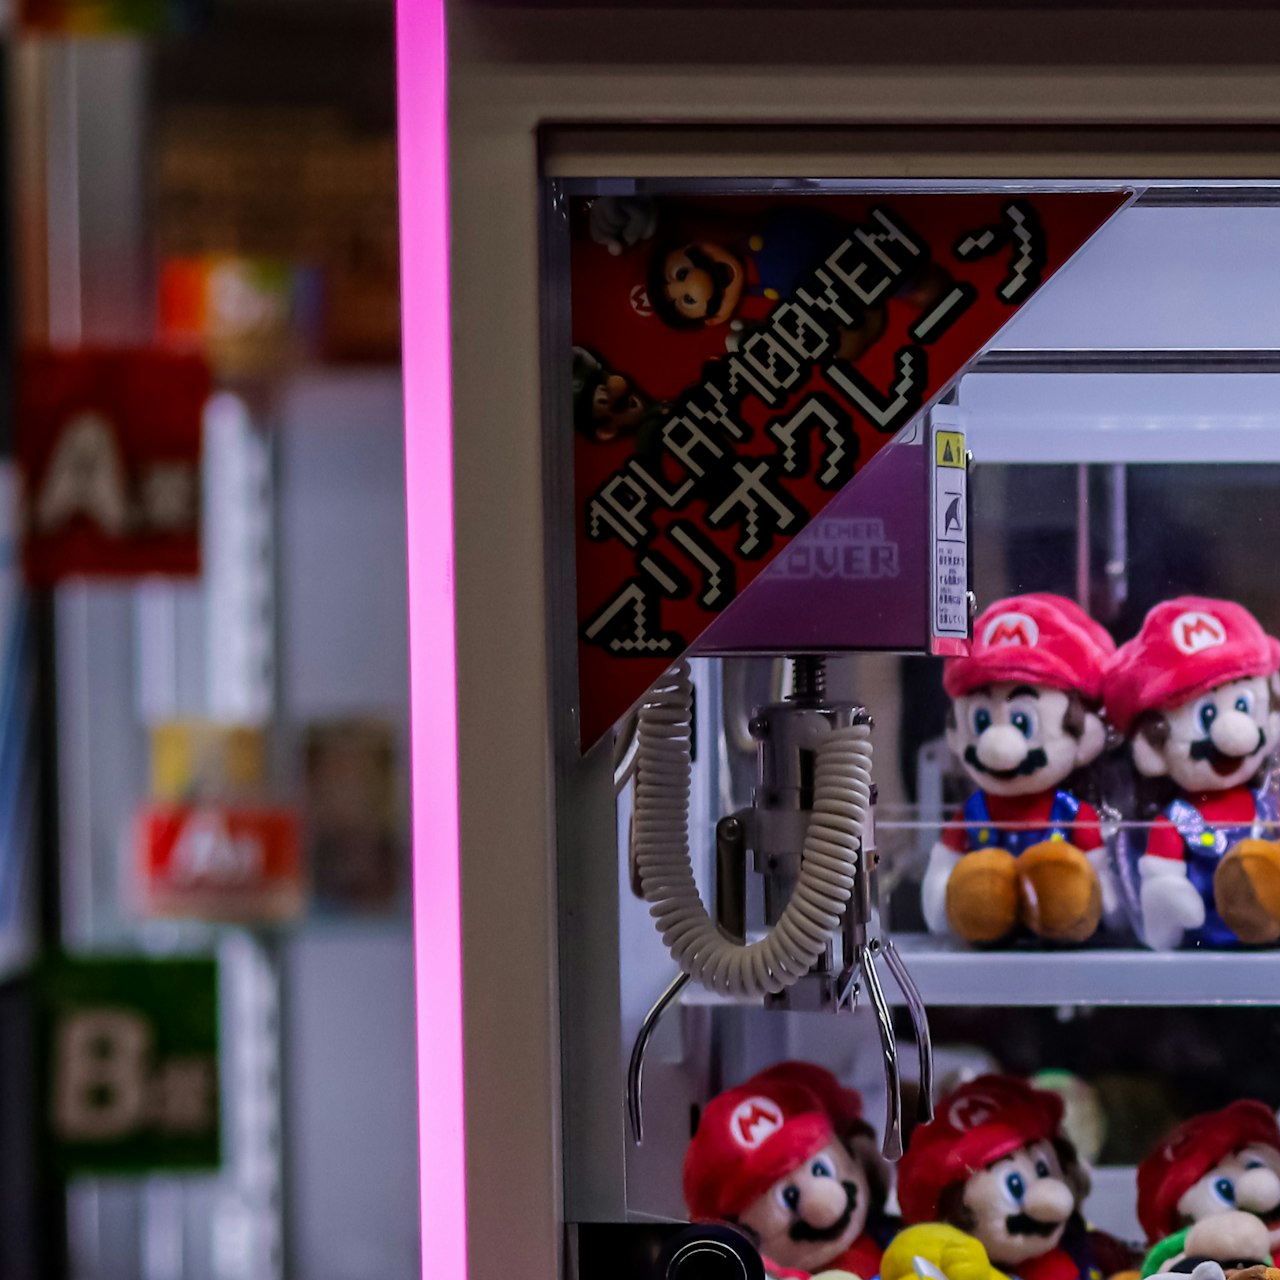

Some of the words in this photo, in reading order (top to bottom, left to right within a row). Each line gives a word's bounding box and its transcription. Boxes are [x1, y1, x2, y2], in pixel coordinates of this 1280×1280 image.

[586, 204, 1034, 650] マリオクレーン
